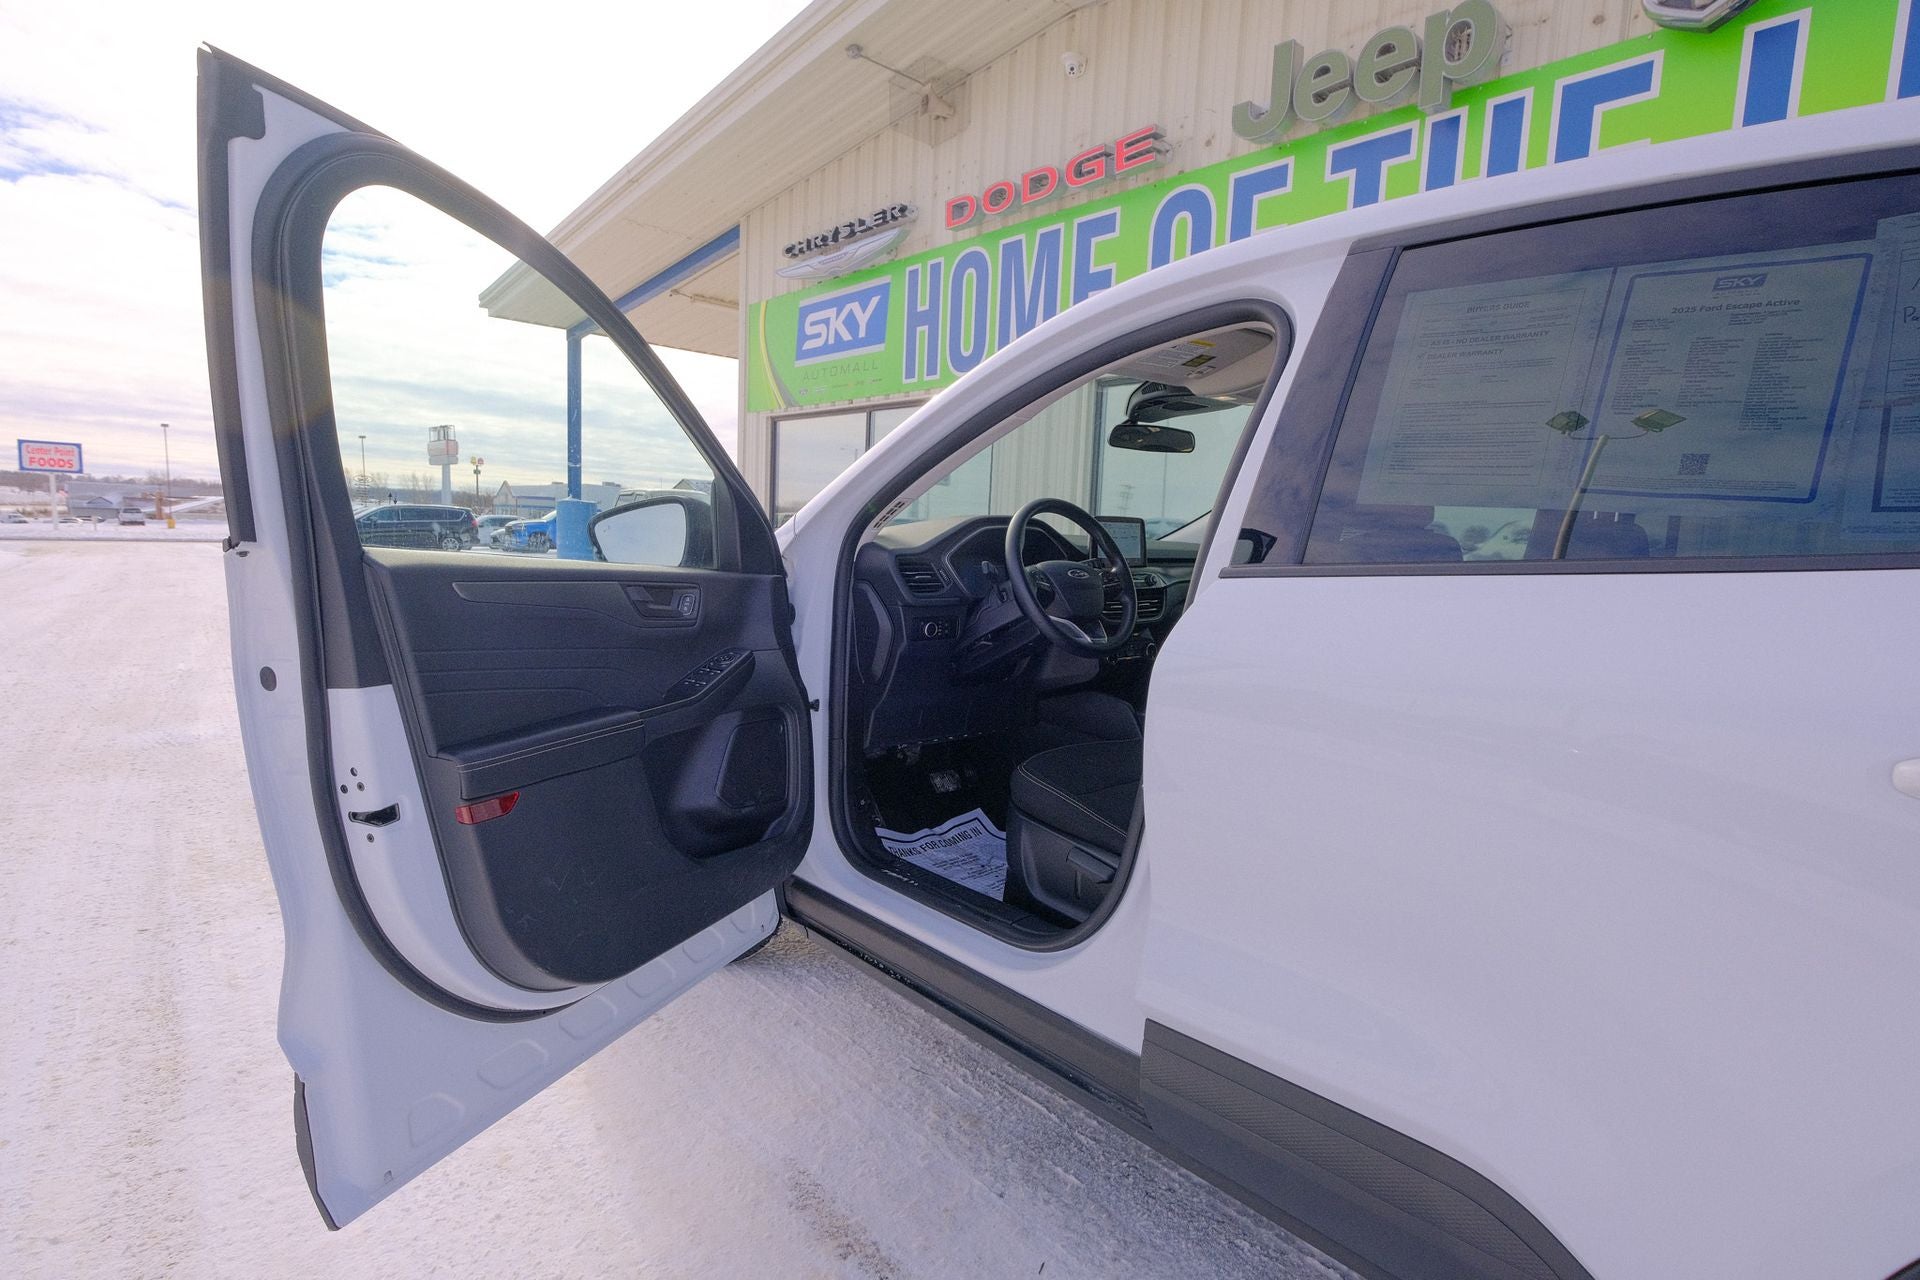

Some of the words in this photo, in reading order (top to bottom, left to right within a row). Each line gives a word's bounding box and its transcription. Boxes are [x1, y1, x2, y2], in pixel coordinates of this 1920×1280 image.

[1231, 0, 1499, 140] Jeep
[945, 124, 1160, 230] DODGE
[783, 203, 909, 259] CHRYSLER
[1717, 274, 1764, 289] SKY
[1671, 306, 1697, 314] 2025
[1700, 304, 1722, 313] Ford
[1725, 302, 1762, 311] Escape
[1765, 299, 1801, 308] Active
[801, 294, 882, 351] SKY
[1469, 334, 1501, 343] DEALER
[1503, 330, 1550, 341] WARRANTY
[803, 359, 879, 381] AUTOMALL
[28, 457, 74, 469] FOODS
[920, 840, 940, 852] FOR
[938, 830, 973, 848] COMING
[970, 826, 983, 838] IN
